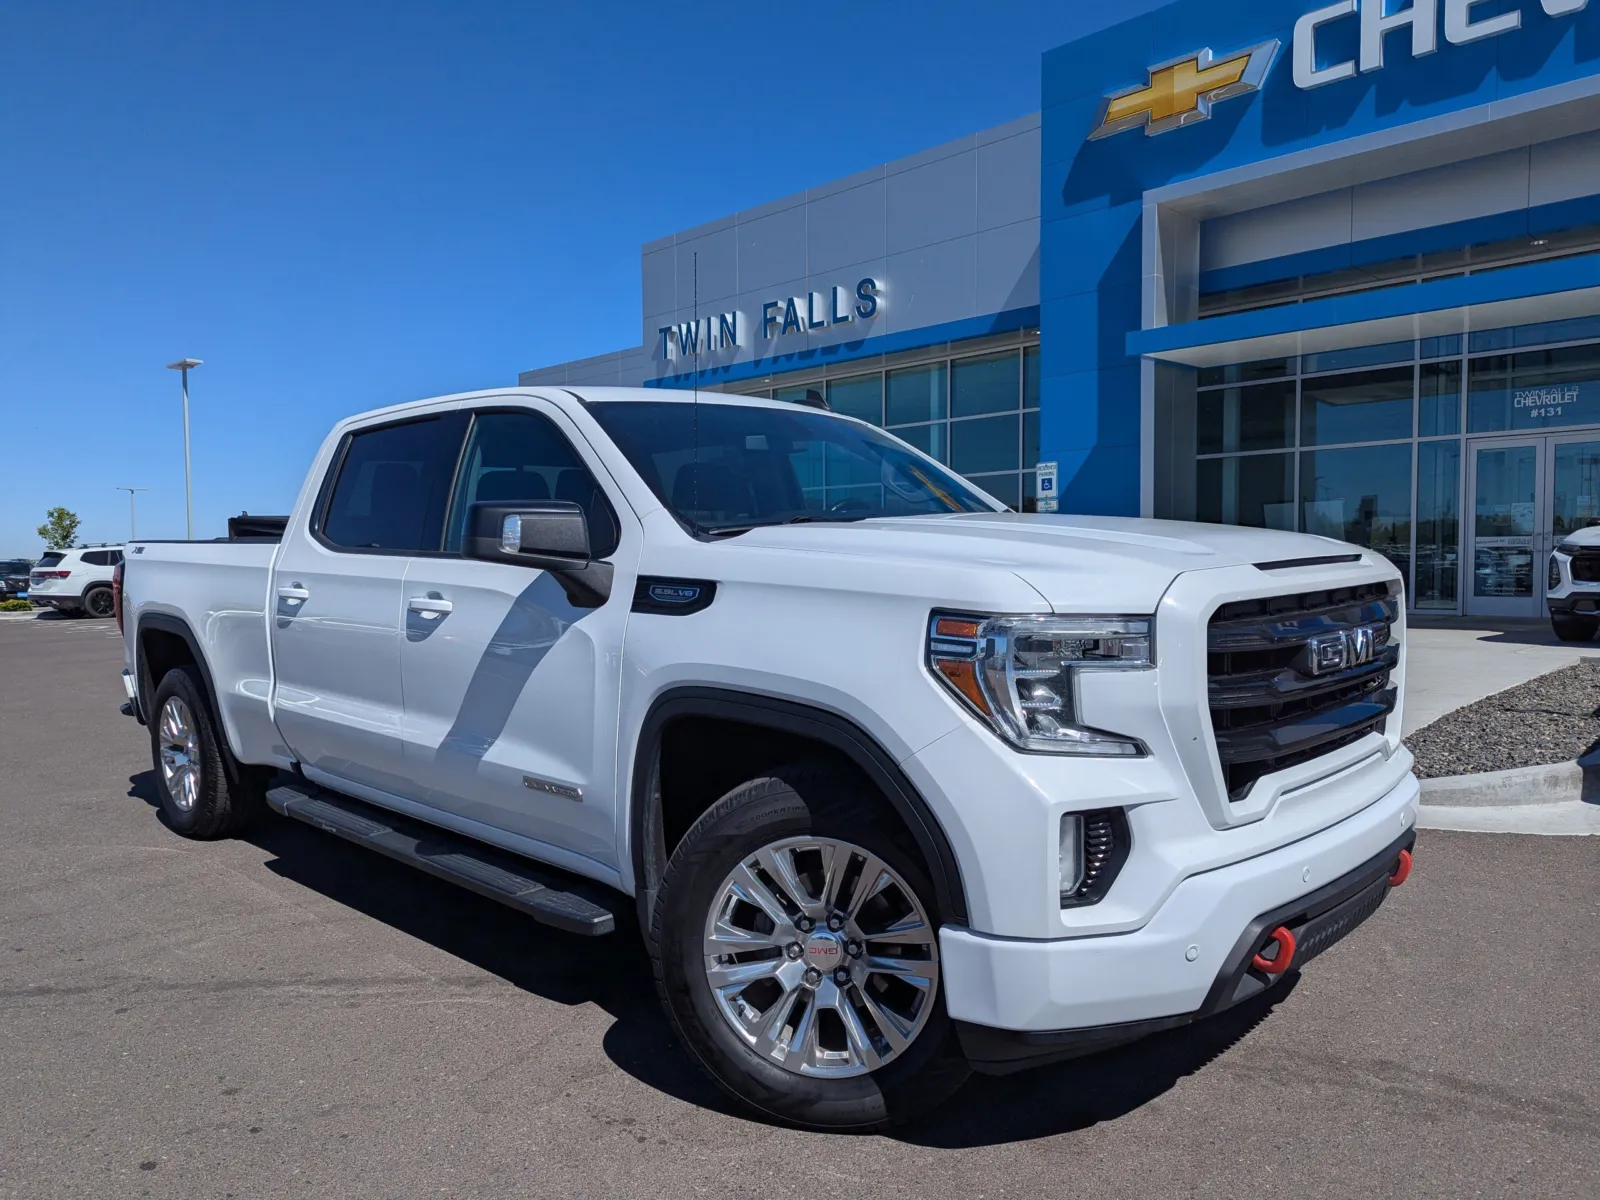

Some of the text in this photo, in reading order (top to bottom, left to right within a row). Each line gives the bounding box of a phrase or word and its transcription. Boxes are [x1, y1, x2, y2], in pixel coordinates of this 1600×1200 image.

[1293, 0, 1588, 89] CHE
[658, 278, 880, 360] TWIN FALLS
[1515, 385, 1579, 398] TWIN FALLS
[1514, 392, 1578, 407] CHEVROLET
[1530, 406, 1562, 418] #131
[808, 946, 838, 955] GMC
